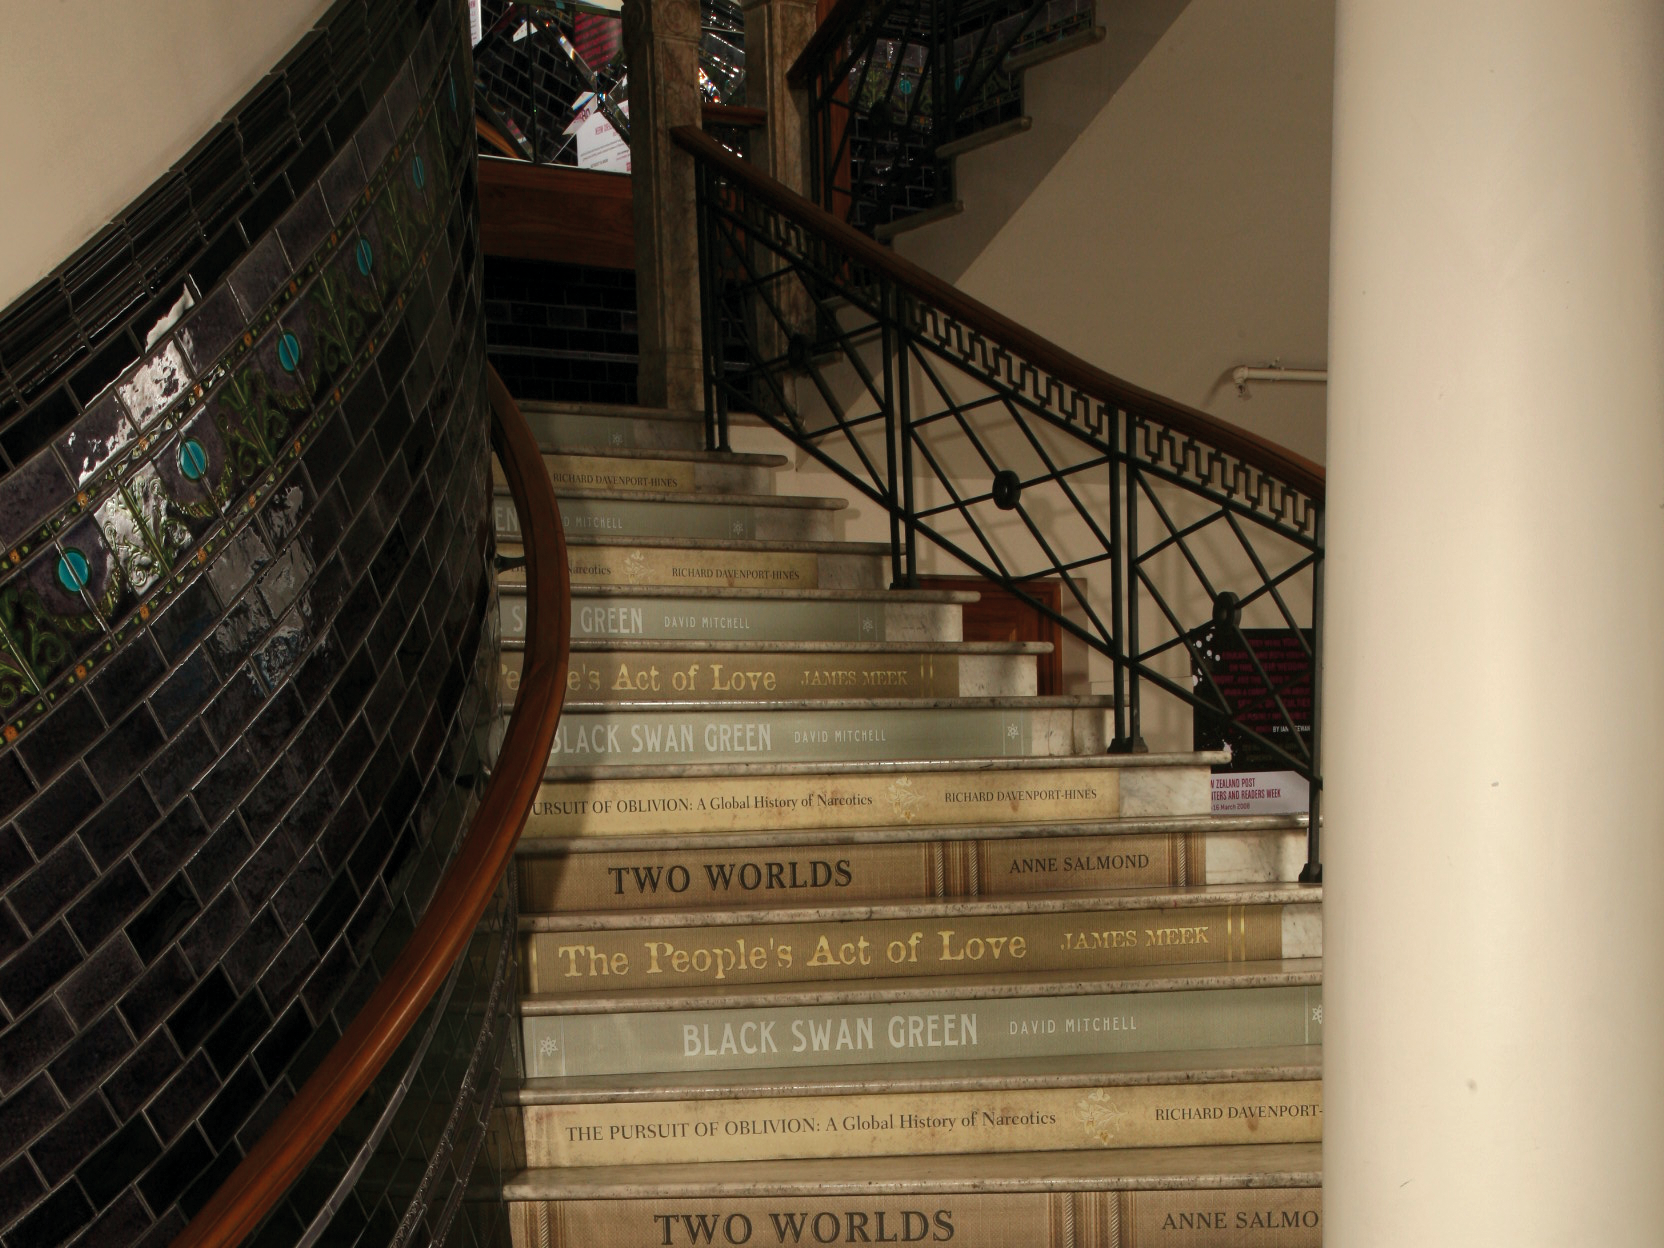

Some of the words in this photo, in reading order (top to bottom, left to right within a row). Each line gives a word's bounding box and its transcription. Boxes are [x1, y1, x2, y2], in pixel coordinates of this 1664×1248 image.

[553, 473, 594, 484] RICHARD
[595, 474, 678, 488] DAVENPORT-HINES
[576, 515, 623, 530] MITCHELL
[672, 567, 713, 578] RICHARD
[716, 568, 799, 580] DAVENPORT-HINES
[580, 606, 643, 634] GREEN
[664, 616, 696, 628] DAVID
[702, 617, 750, 629] MITCHELL
[611, 664, 661, 691] Act
[672, 664, 699, 691] of
[710, 664, 777, 692] Love
[801, 670, 856, 686] JAMES
[862, 671, 908, 686] MEEK
[552, 724, 621, 753] BLACK
[631, 724, 694, 753] SWAN
[705, 723, 772, 752] GREEN
[794, 730, 829, 743] DAVID
[835, 729, 887, 743] MITCHELL
[1216, 778, 1240, 789] ZEALAND
[1241, 777, 1255, 788] POST
[1228, 790, 1239, 800] AND
[1241, 789, 1265, 799] READERS
[1266, 788, 1281, 798] WEEK
[533, 801, 588, 815] URSUIT
[592, 800, 613, 814] OF
[617, 797, 693, 814] OBLIVION:
[697, 798, 707, 811] A
[710, 796, 750, 811] Global
[754, 795, 797, 811] History
[801, 793, 814, 808] of
[818, 793, 873, 807] Narcotics
[945, 790, 994, 803] RICHARD
[997, 788, 1097, 802] DAVENPORT-HINES
[608, 865, 691, 894] TWO
[704, 859, 852, 891] WORLDS
[1010, 858, 1058, 874] ANNE
[1064, 854, 1150, 872] SALMOND
[558, 944, 629, 977] The
[644, 937, 793, 979] People's
[807, 935, 871, 967] Act
[886, 931, 923, 964] of
[937, 930, 1027, 961] Love
[1060, 930, 1138, 951] JAMES
[1145, 926, 1209, 947] MEEK
[683, 1021, 778, 1056] BLACK
[792, 1017, 873, 1053] SWAN
[888, 1014, 978, 1049] GREEN
[1010, 1020, 1056, 1036] DAVID
[1066, 1016, 1137, 1033] MITCHELL
[566, 1125, 604, 1142] THE
[610, 1122, 689, 1140] PURSUIT
[694, 1121, 719, 1137] OF
[725, 1117, 821, 1136] OBLIVION:
[825, 1117, 838, 1132] A
[843, 1114, 894, 1131] Global
[899, 1113, 955, 1132] History
[961, 1111, 978, 1127] of
[982, 1110, 1056, 1128] Narcotics
[1155, 1106, 1223, 1121] RICHARD
[1228, 1104, 1323, 1120] DAVENPORT-
[654, 1213, 752, 1246] TWO
[768, 1209, 955, 1244] WORLDS
[1162, 1212, 1227, 1230] ANNE
[1236, 1210, 1319, 1229] SALMO
